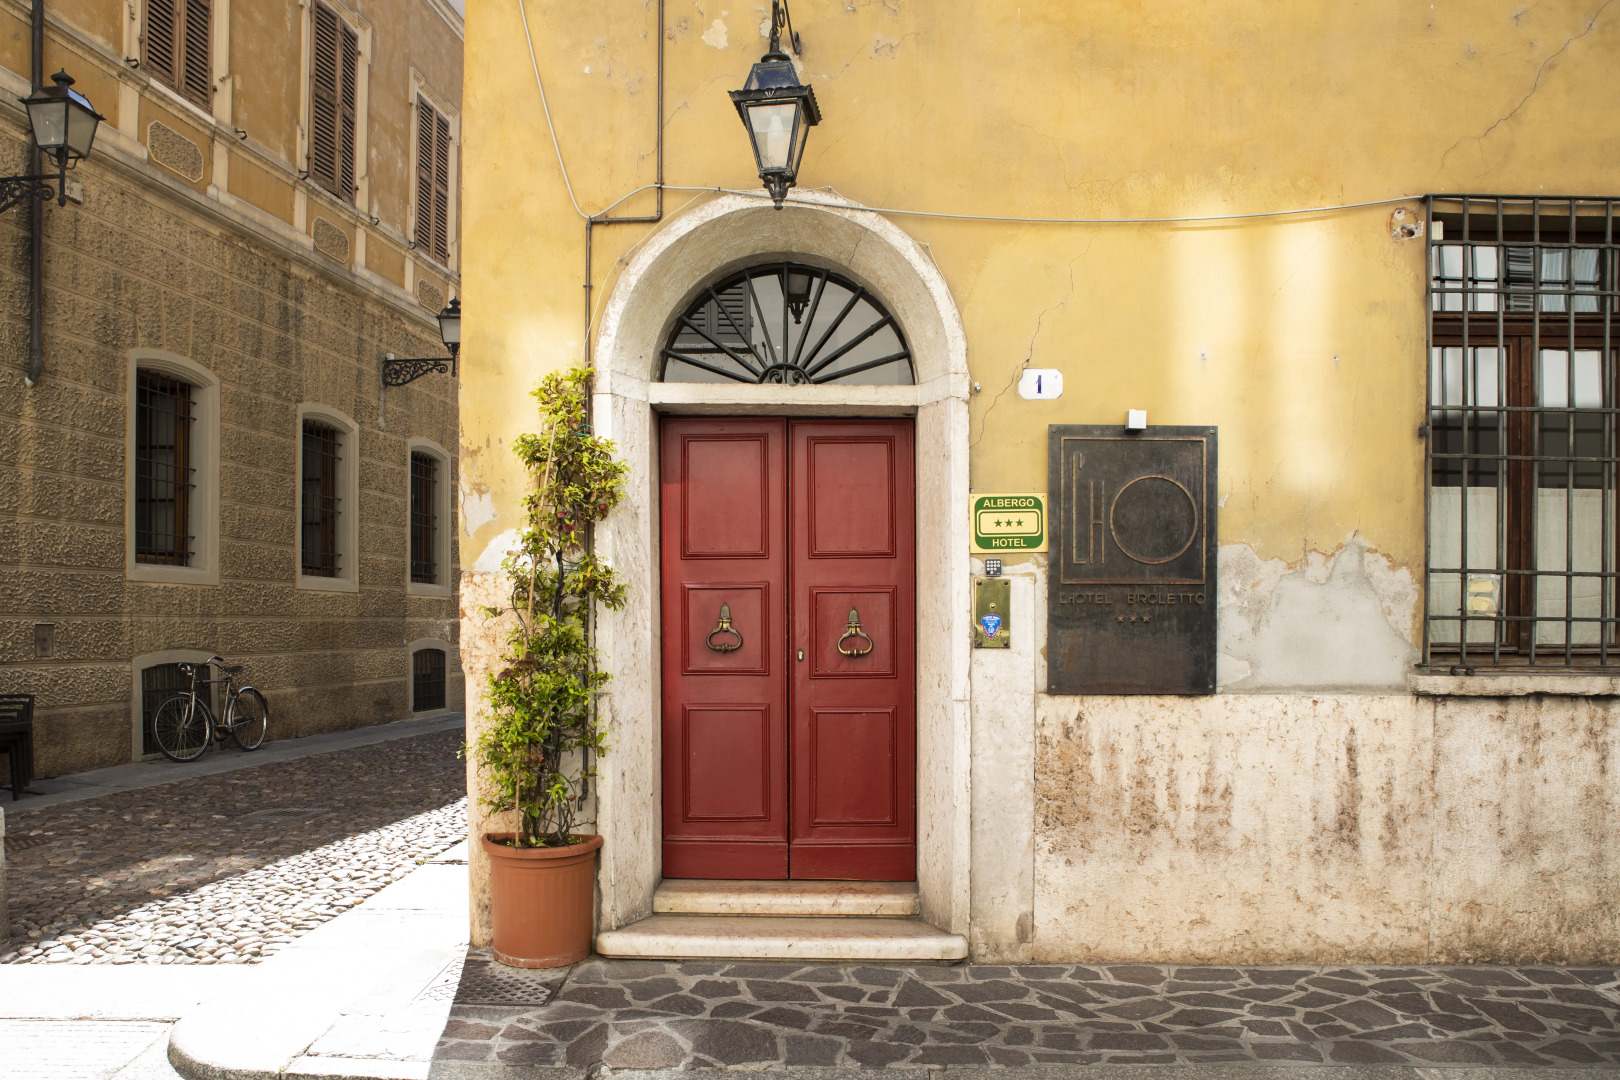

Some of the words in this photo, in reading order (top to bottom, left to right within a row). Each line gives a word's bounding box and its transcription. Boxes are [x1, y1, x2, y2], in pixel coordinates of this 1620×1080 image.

[1035, 374, 1042, 394] 1
[983, 498, 1035, 508] ALBERGO
[992, 538, 1028, 547] HOTEL
[1127, 592, 1206, 605] BROLETTO
